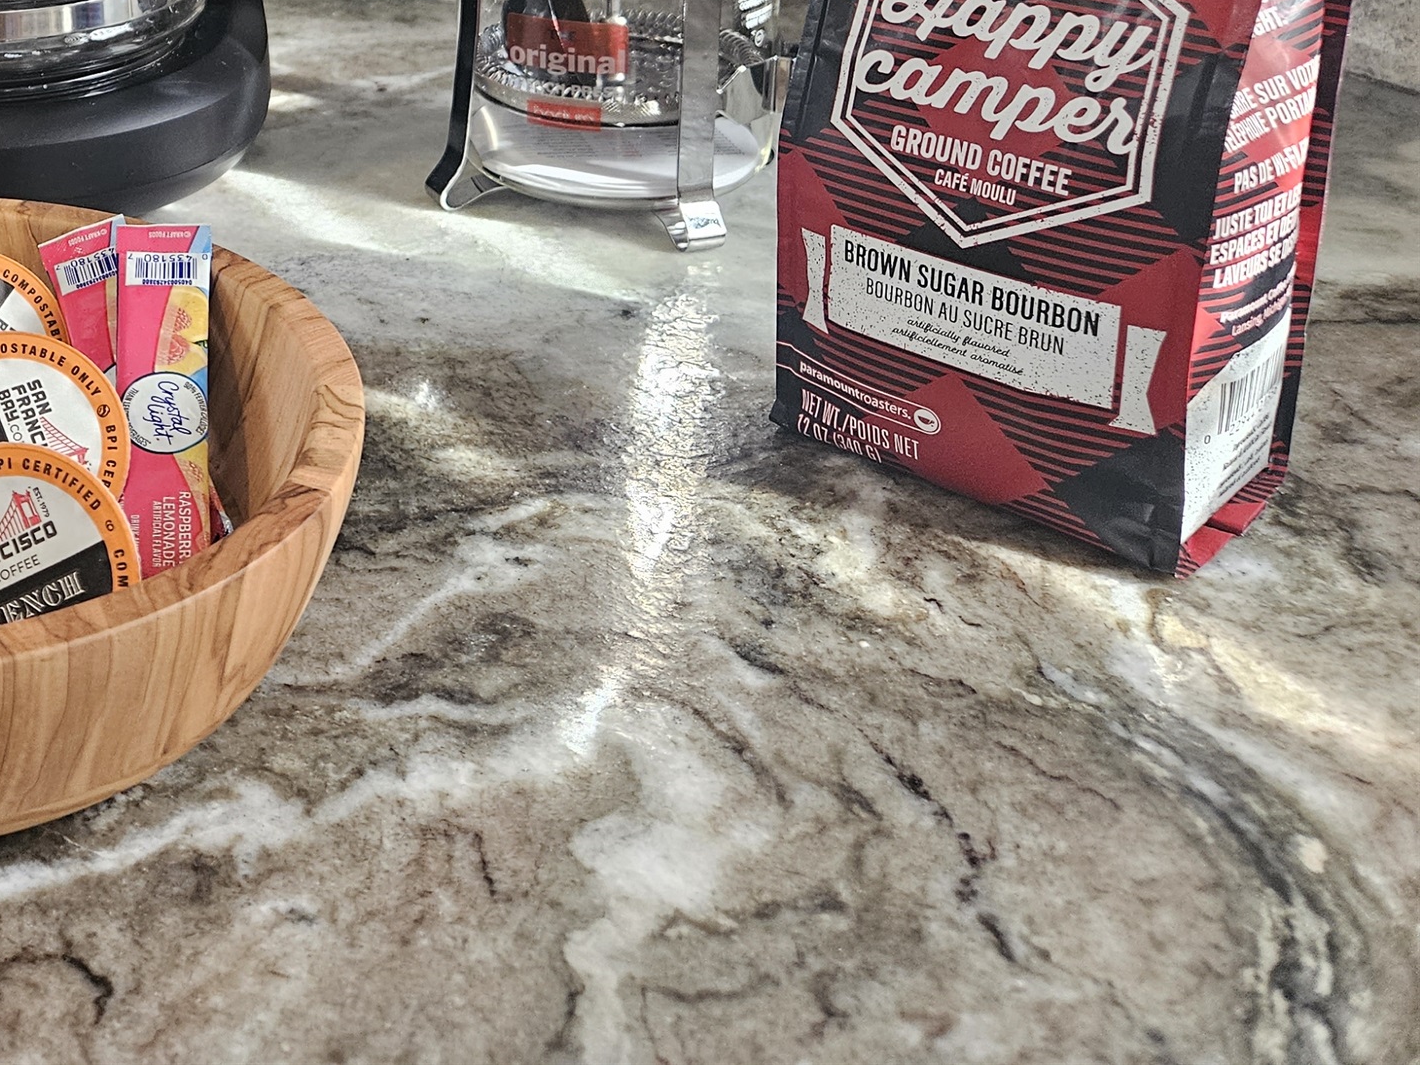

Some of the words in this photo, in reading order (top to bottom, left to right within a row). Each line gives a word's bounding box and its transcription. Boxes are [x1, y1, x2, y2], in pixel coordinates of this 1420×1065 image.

[510, 44, 626, 75] original
[855, 50, 1135, 155] camper
[1254, 75, 1290, 104] SUR
[890, 125, 982, 169] GROUND
[987, 150, 1072, 196] COFFEE
[1233, 167, 1258, 194] PAS
[1258, 158, 1275, 184] DE
[934, 169, 969, 193] CAFÉ
[970, 179, 1016, 206] MOULU
[1213, 208, 1254, 240] JUSTE
[1254, 199, 1273, 225] TOI
[144, 255, 192, 263] 435180
[1210, 229, 1266, 265] ESPACES
[1213, 250, 1268, 288] LAVEURS
[845, 240, 911, 282] BROWN
[917, 264, 984, 306] SUGAR
[991, 285, 1100, 336] BOURBON
[866, 278, 934, 315] BOURBON
[938, 302, 958, 323] AU
[963, 311, 1014, 341] SUCRE
[1019, 326, 1064, 355] BRUN
[907, 318, 961, 343] artificially
[962, 335, 1009, 357] flavored
[892, 328, 967, 357] artificiellement
[970, 353, 1023, 376] aromatisé
[27, 379, 52, 414] SAN
[72, 366, 101, 396] ONLY
[106, 425, 117, 451] BPI
[151, 381, 192, 435] Crystal
[800, 361, 911, 420] paramountroasters.
[798, 414, 810, 436] 12
[813, 423, 831, 443] OZ
[865, 445, 881, 463] G)
[802, 389, 822, 418] NET
[822, 401, 889, 449] WT./POIDS
[894, 434, 919, 460] NET
[22, 458, 101, 511] CERTIFIED
[32, 487, 43, 502] EST.
[39, 502, 50, 518] 1979
[152, 501, 162, 537] ARTIFICIAL
[163, 496, 175, 567] LEMONADE
[179, 492, 191, 563] RASPBERR
[152, 540, 161, 567] FLAVOR
